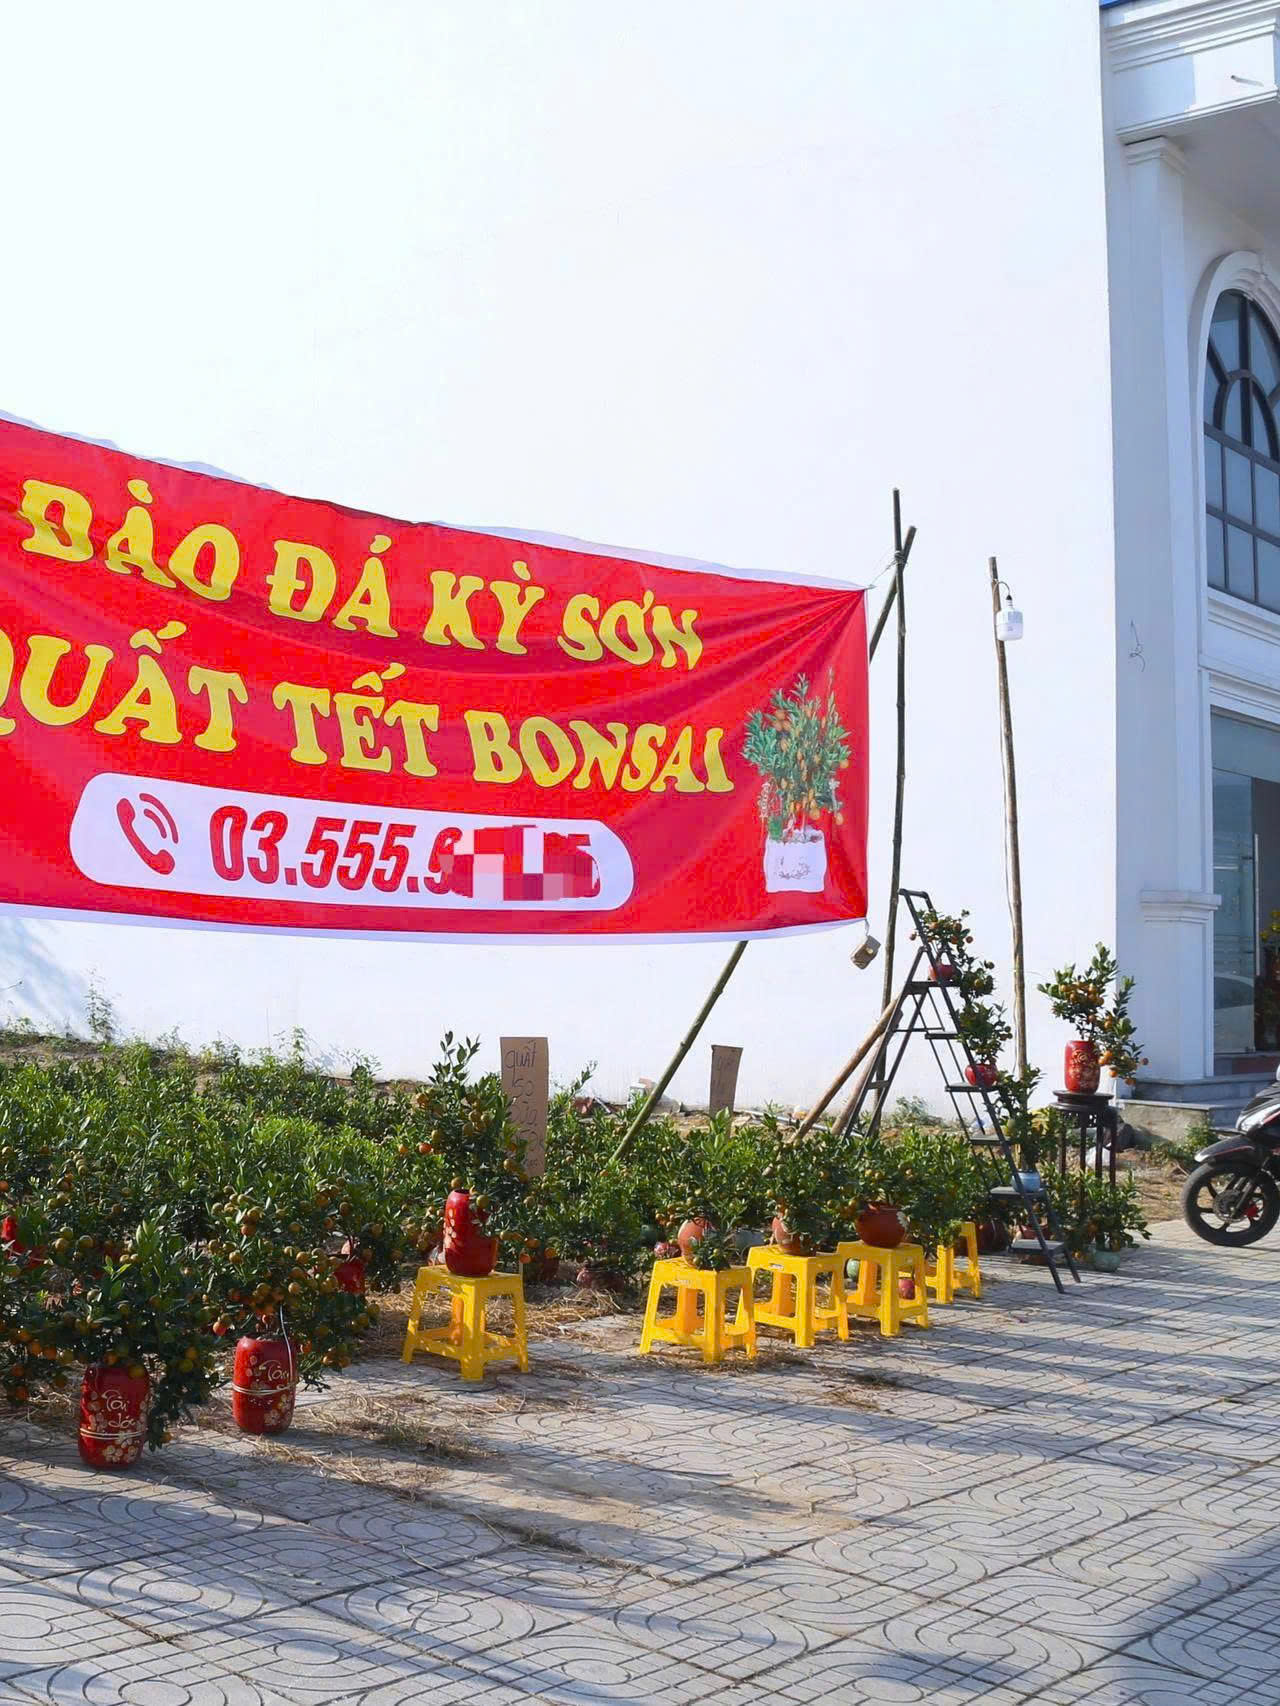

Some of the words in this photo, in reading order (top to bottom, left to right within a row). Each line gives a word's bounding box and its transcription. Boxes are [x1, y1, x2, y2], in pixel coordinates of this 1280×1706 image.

[266, 534, 398, 638] ĐÁ
[422, 560, 546, 655] KỲ
[556, 589, 704, 670] SƠN
[271, 660, 441, 779] TẾT
[463, 709, 736, 794] BONSAI
